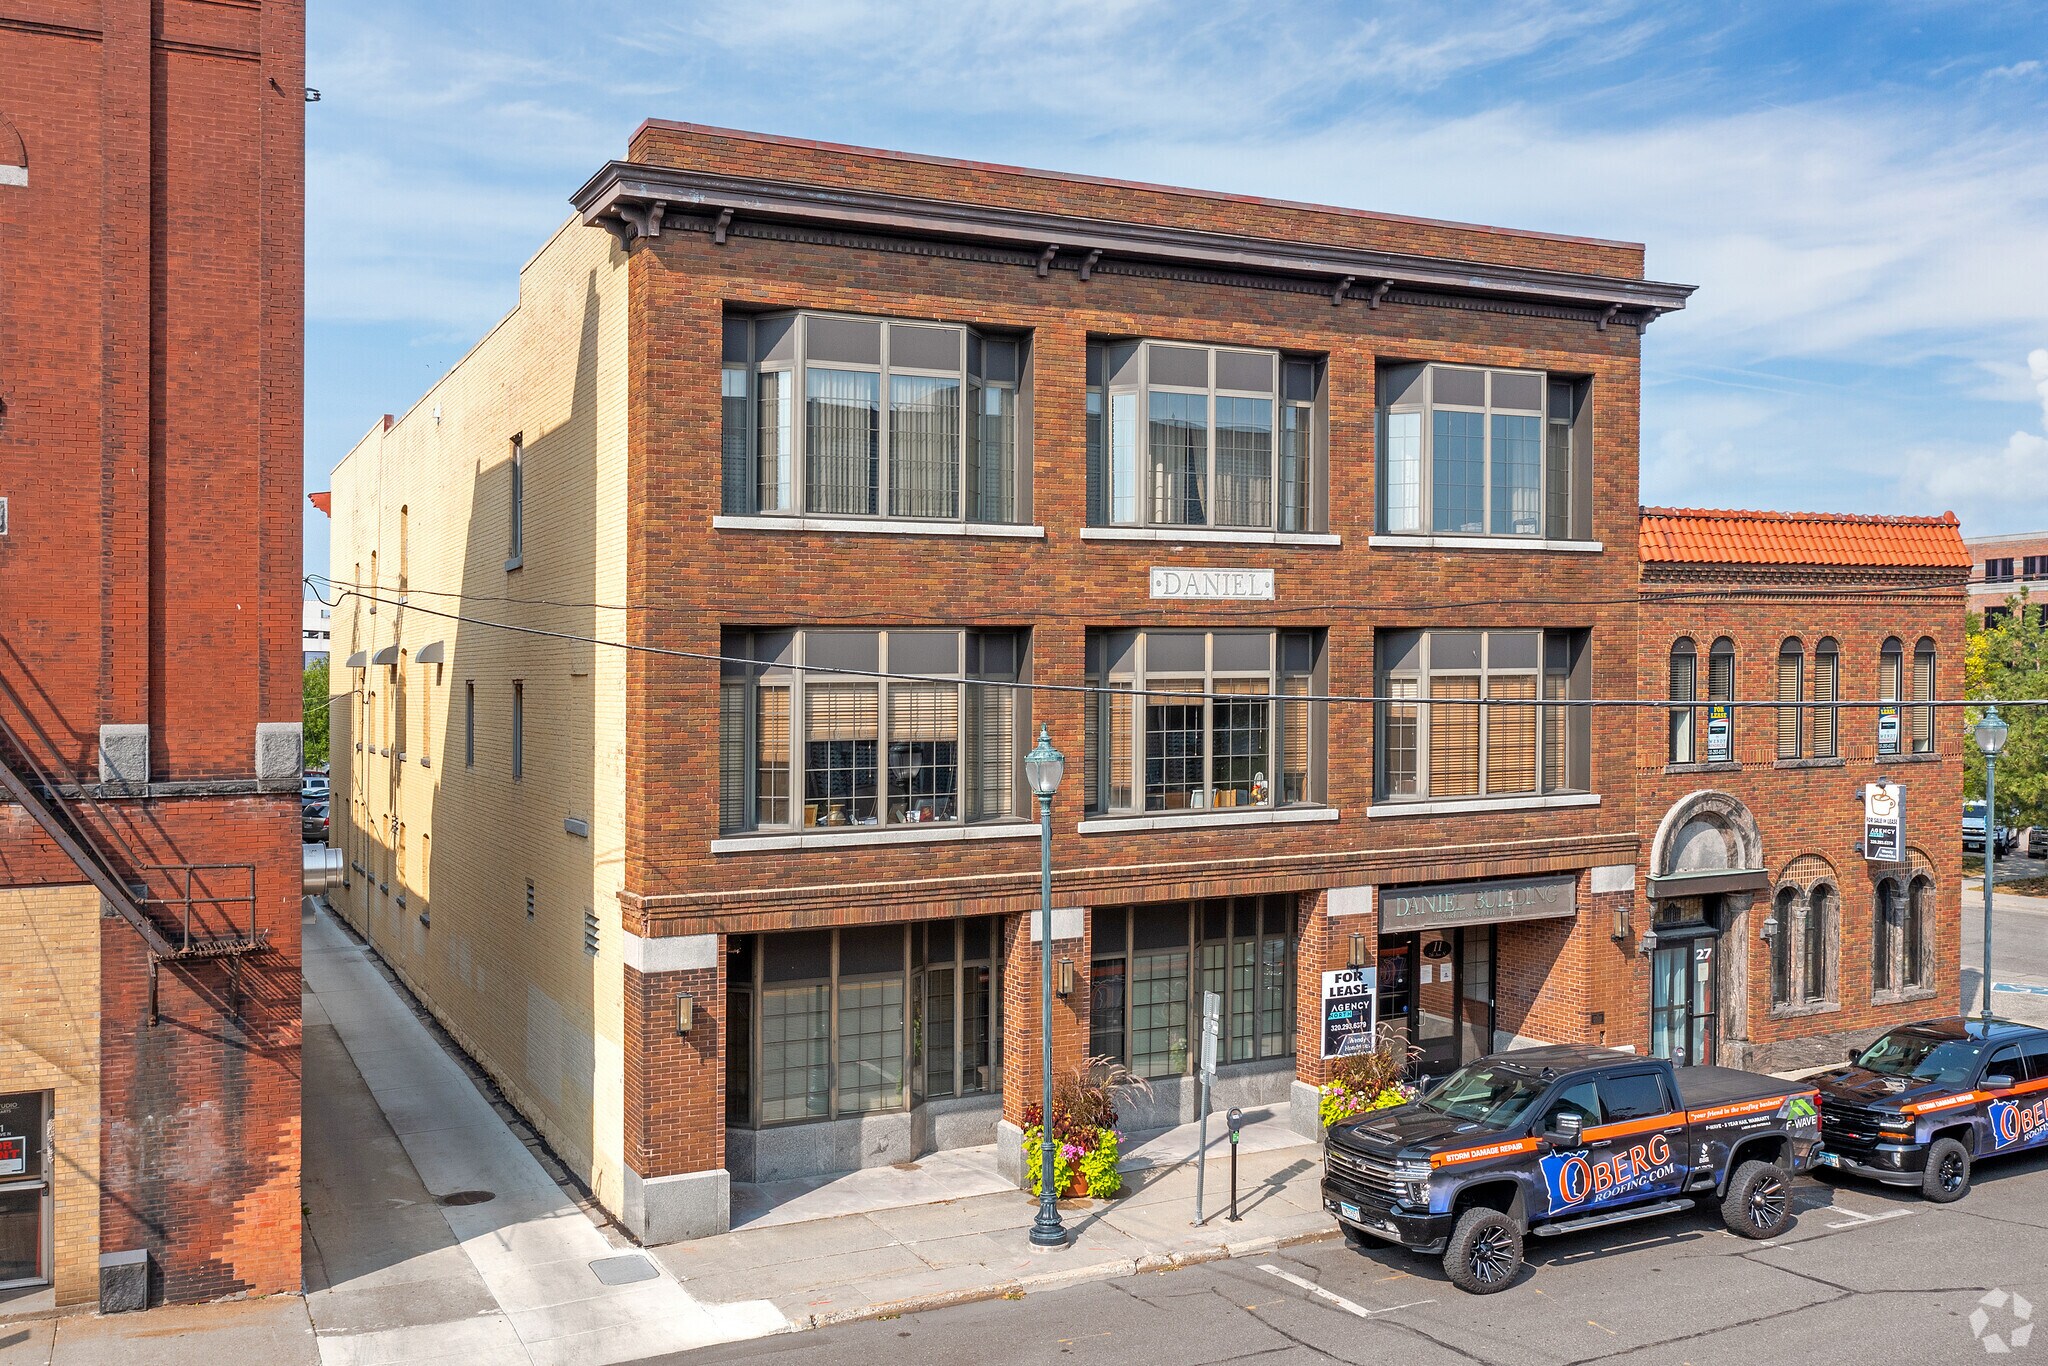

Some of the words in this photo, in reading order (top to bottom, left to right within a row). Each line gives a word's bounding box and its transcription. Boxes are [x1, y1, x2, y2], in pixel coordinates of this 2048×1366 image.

[1163, 572, 1263, 596] DANIEL
[1870, 827, 1896, 835] AGENCY
[1396, 892, 1466, 917] DANIEL
[1474, 885, 1558, 909] BUILDING
[1696, 947, 1712, 960] 27
[1334, 971, 1364, 984] FOR
[1329, 983, 1369, 997] LEASE
[1331, 1000, 1370, 1013] AGENCY
[1329, 1010, 1353, 1019] NORTH
[1707, 1107, 1724, 1118] friend
[1731, 1105, 1740, 1113] the
[1740, 1102, 1760, 1112] roofing
[1748, 1115, 1770, 1123] WARRANTY
[1785, 1115, 1817, 1131] F-WAVE
[1445, 1151, 1470, 1162] STORM
[1471, 1146, 1500, 1158] DAMAGE
[1500, 1142, 1524, 1153] REPAIR
[1559, 1134, 1670, 1203] OBERG
[1594, 1162, 1675, 1203] ROOFING.COM
